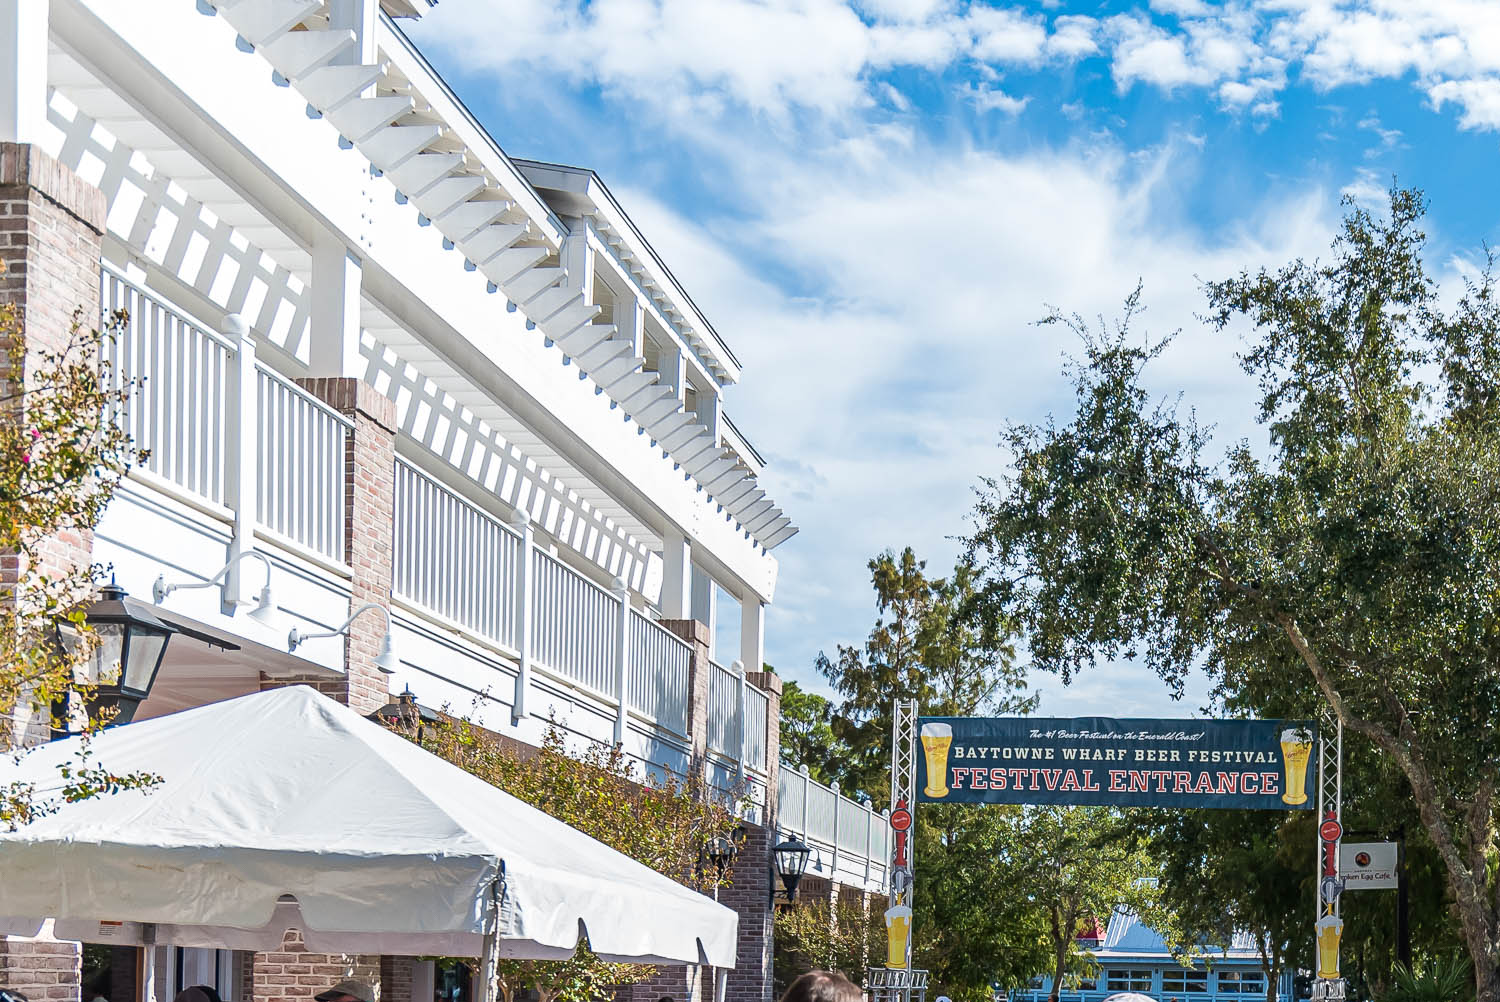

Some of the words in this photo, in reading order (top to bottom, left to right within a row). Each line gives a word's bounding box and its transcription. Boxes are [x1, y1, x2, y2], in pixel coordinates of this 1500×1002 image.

[1029, 729, 1043, 739] The
[1044, 729, 1057, 739] #1
[1057, 729, 1079, 739] Beer
[1079, 730, 1114, 740] Festival
[1124, 731, 1138, 740] the
[1138, 731, 1176, 741] Emerald
[1176, 731, 1204, 740] Coast!
[954, 746, 1055, 760] BAYTOWNE
[1062, 748, 1127, 761] WHARF
[1134, 749, 1181, 762] BEER
[1188, 750, 1278, 763] FESTIVAL
[951, 766, 1100, 792] FESTIVAL
[1108, 769, 1279, 795] ENTRANCE
